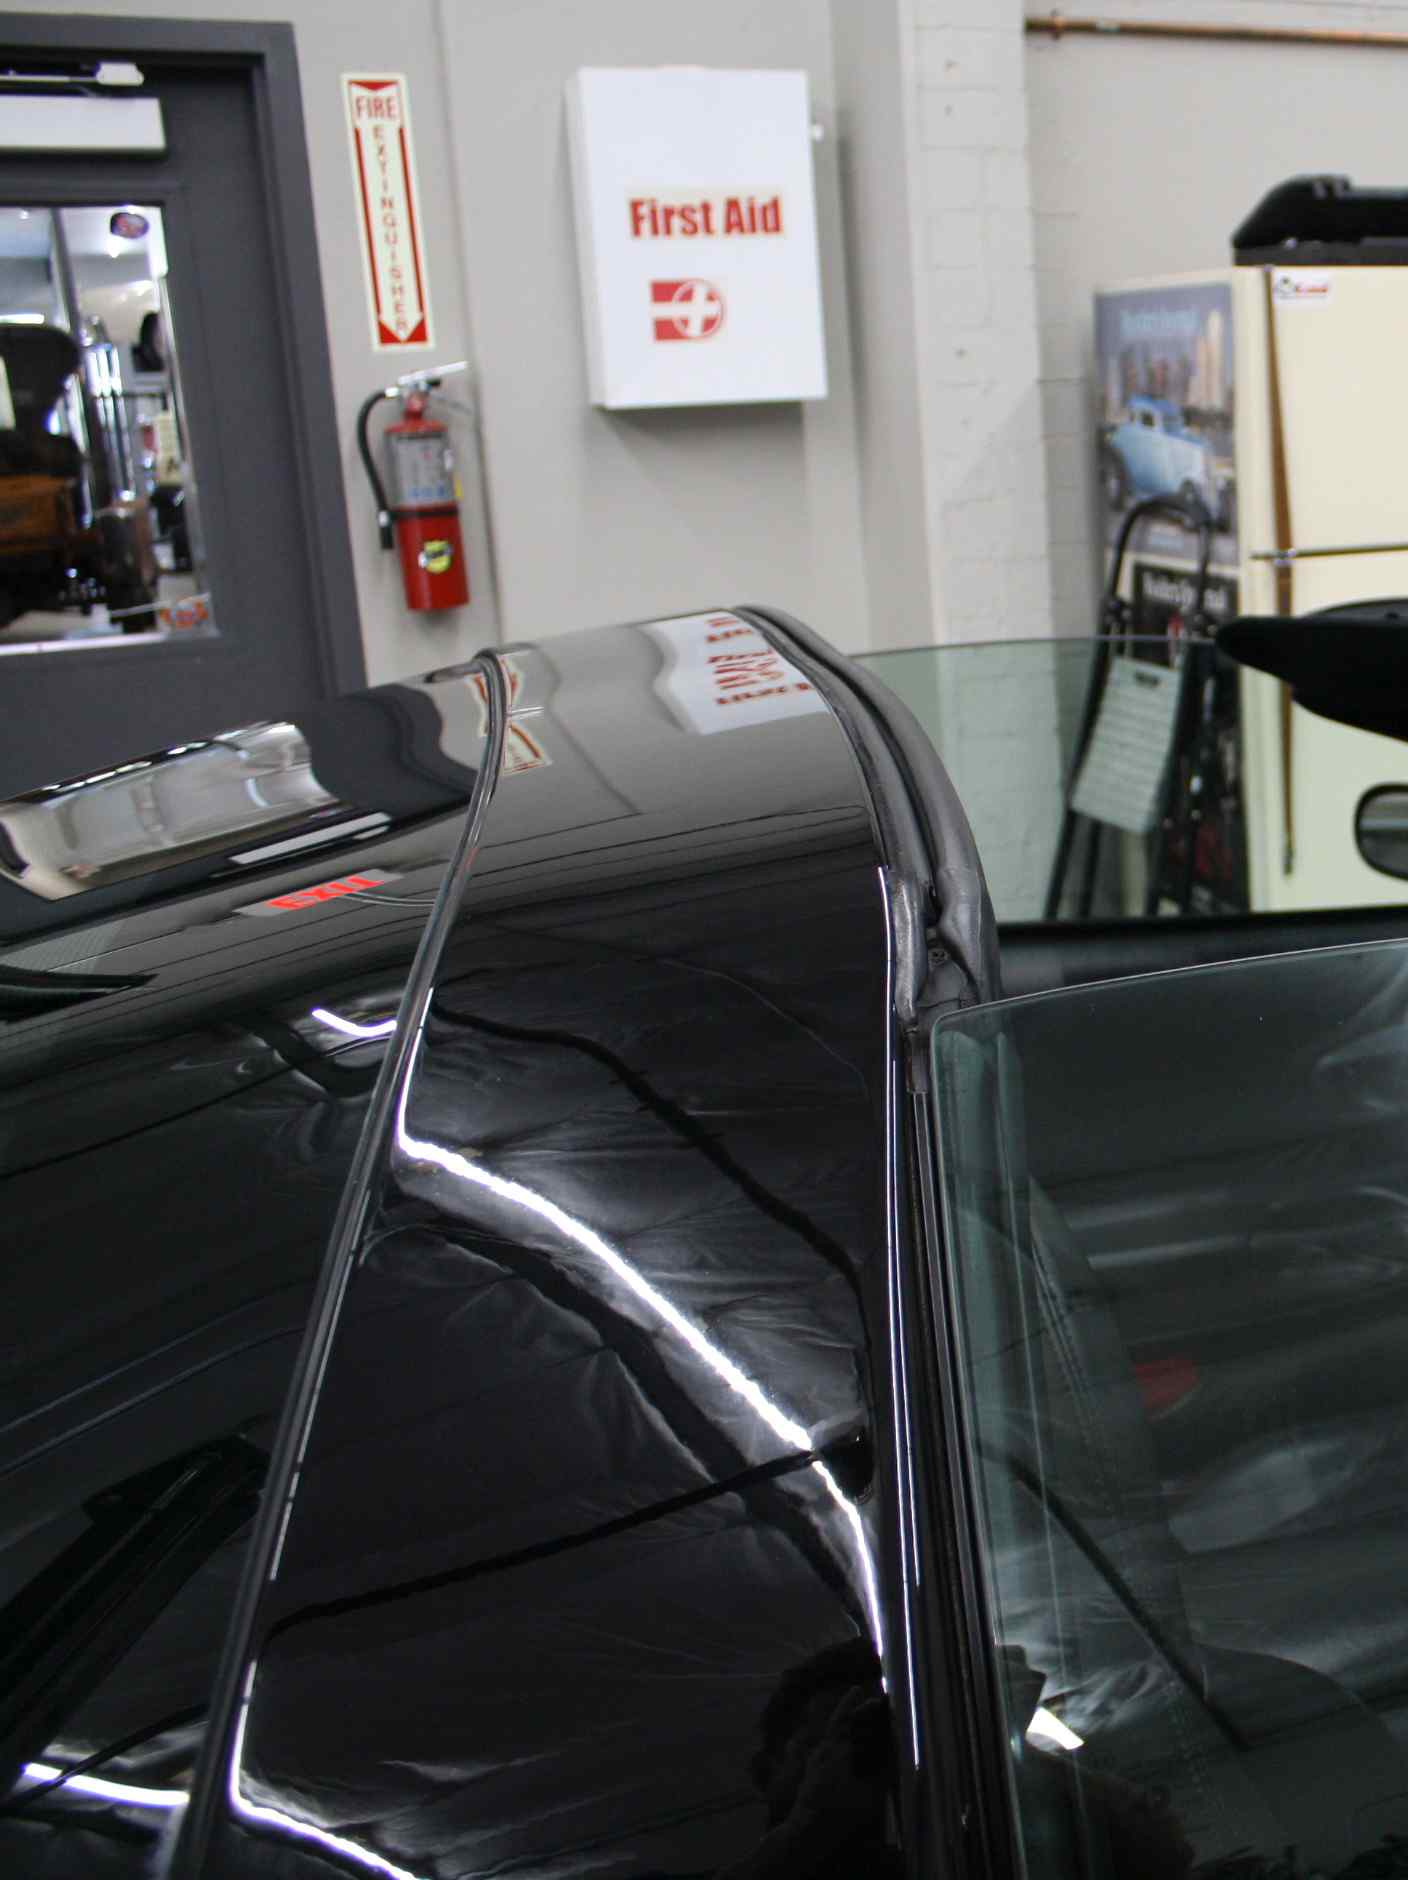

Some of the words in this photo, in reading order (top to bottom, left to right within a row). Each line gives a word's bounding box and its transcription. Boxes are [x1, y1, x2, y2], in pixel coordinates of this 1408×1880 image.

[355, 95, 397, 120] FIRE
[372, 123, 409, 333] EXTINGUISHER
[629, 196, 713, 237] First
[724, 194, 783, 235] Aid
